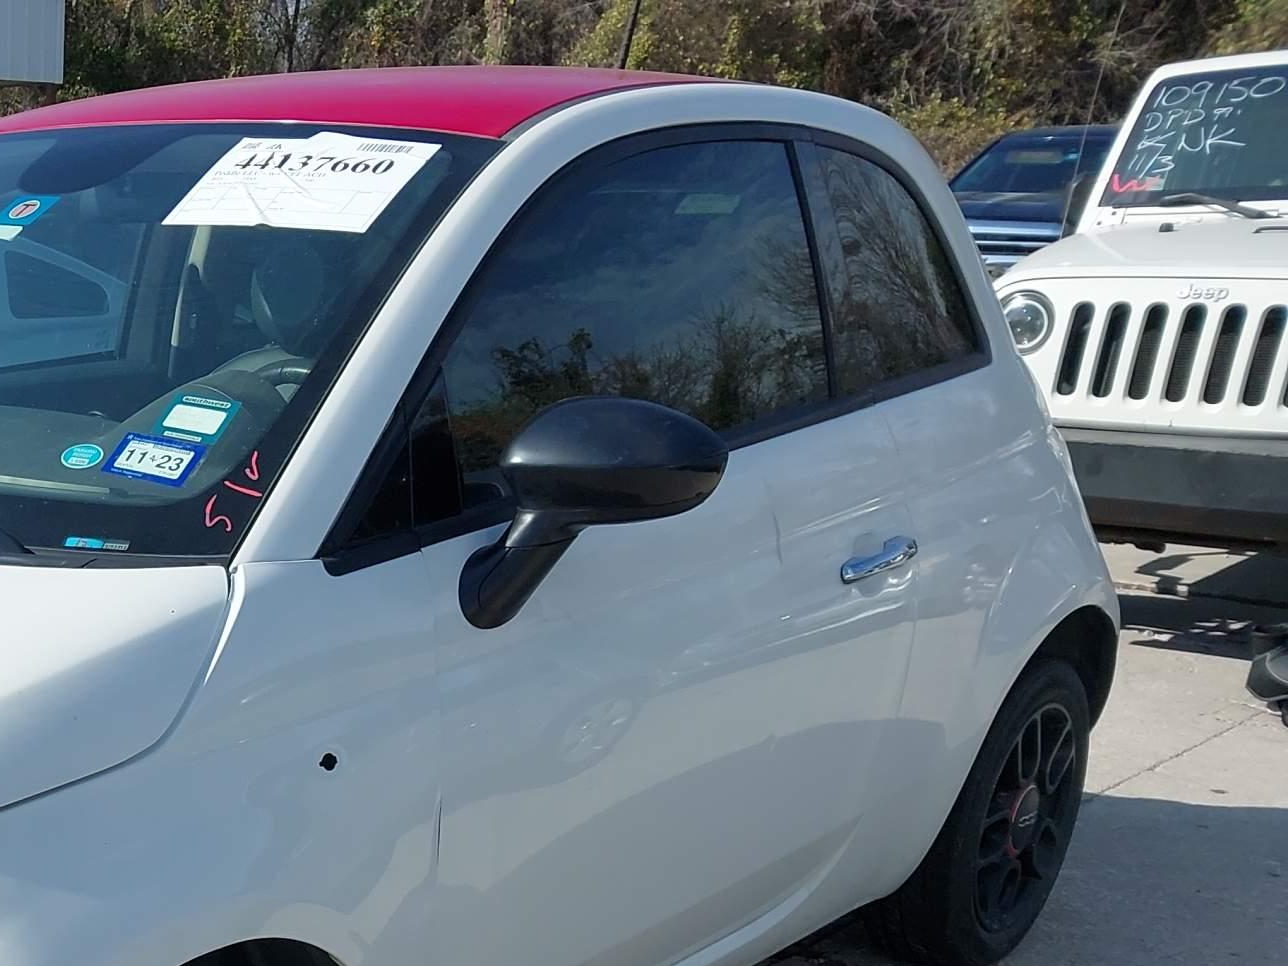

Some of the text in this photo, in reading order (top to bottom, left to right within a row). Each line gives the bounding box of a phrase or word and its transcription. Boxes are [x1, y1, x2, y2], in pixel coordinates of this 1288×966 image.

[235, 151, 396, 176] 44137660
[1176, 283, 1230, 303] Jeep
[125, 448, 149, 465] 11
[155, 454, 185, 472] 23
